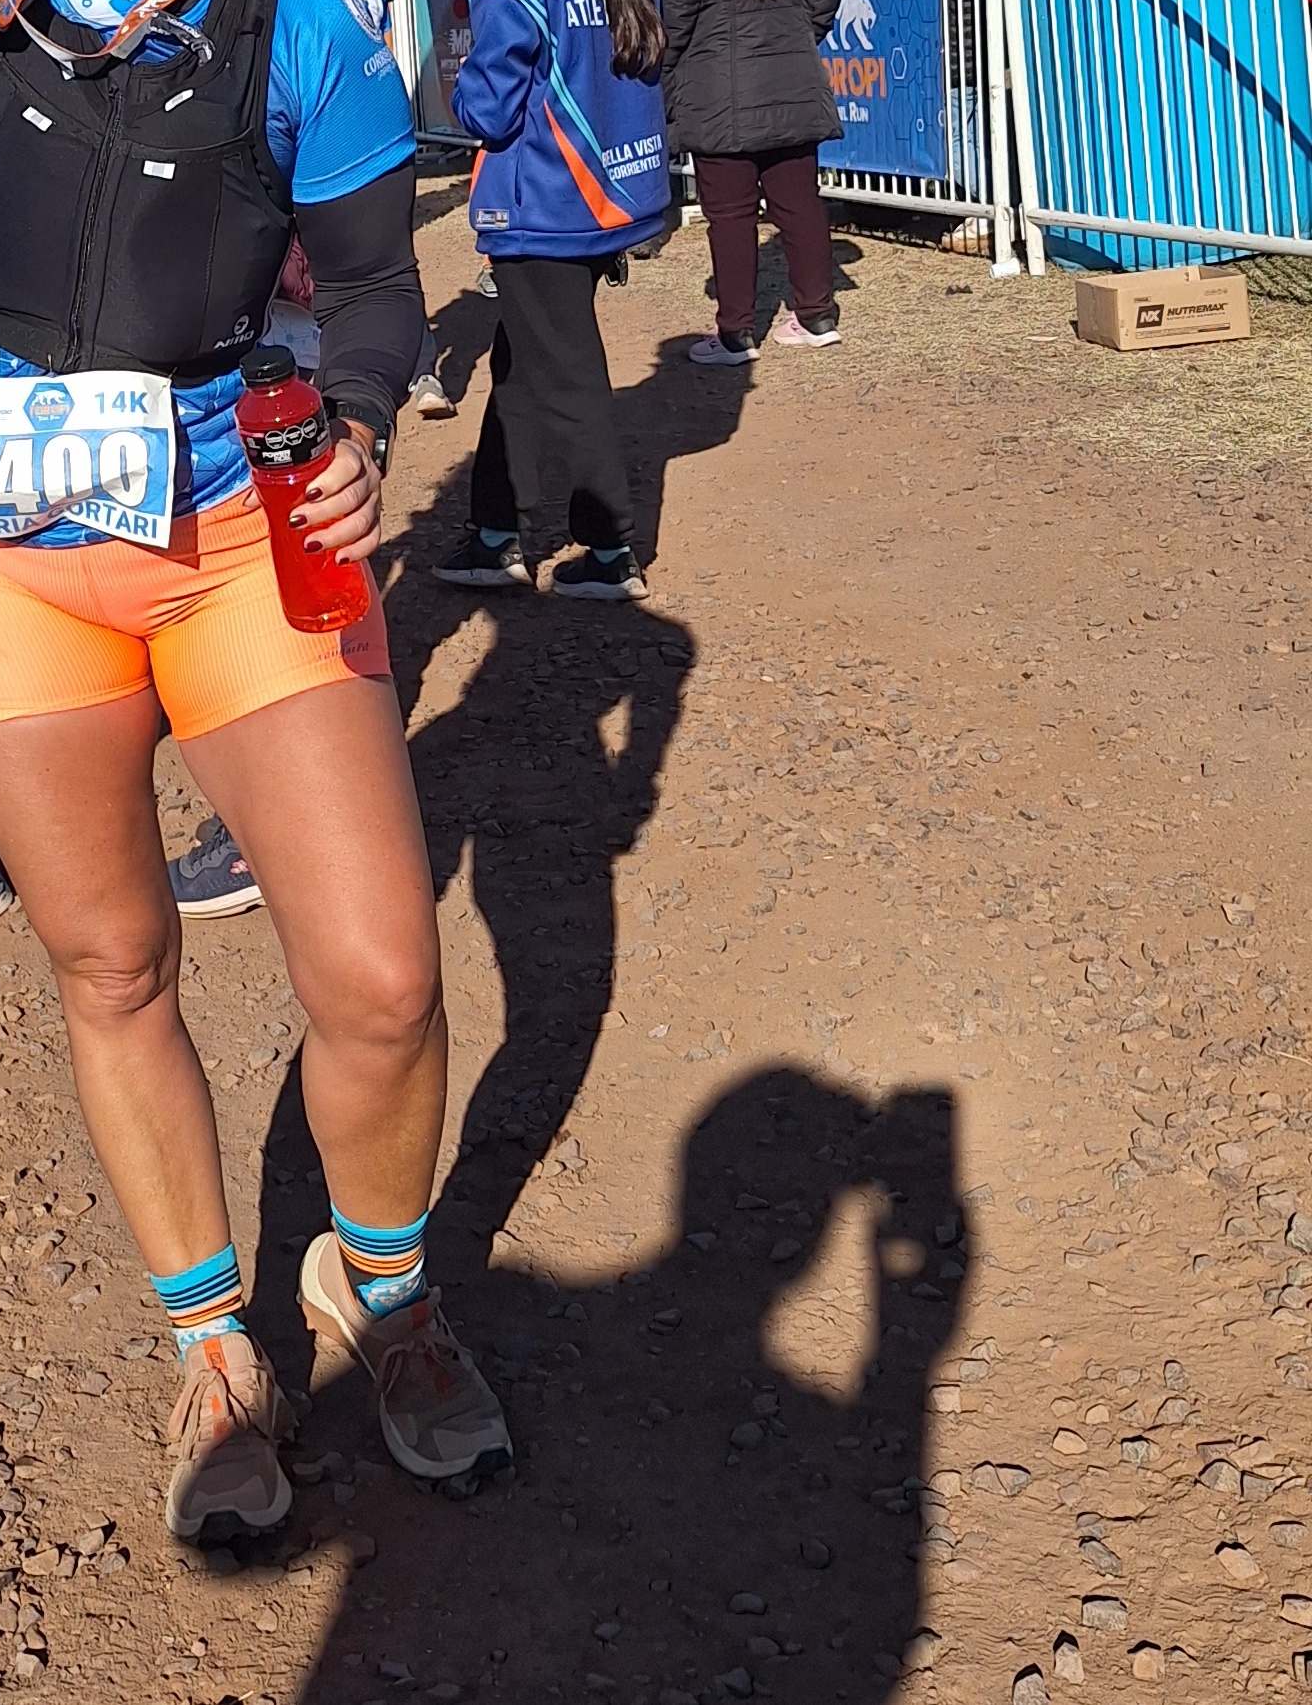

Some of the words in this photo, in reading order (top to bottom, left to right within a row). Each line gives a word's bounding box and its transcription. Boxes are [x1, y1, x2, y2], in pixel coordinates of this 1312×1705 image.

[848, 101, 869, 123] RUN
[602, 142, 634, 168] BELLA
[635, 133, 663, 157] VISTA
[608, 153, 661, 182] CORRIENTES
[1140, 309, 1161, 323] NX
[1167, 302, 1228, 316] NUTREMAX
[94, 390, 149, 414] 14K
